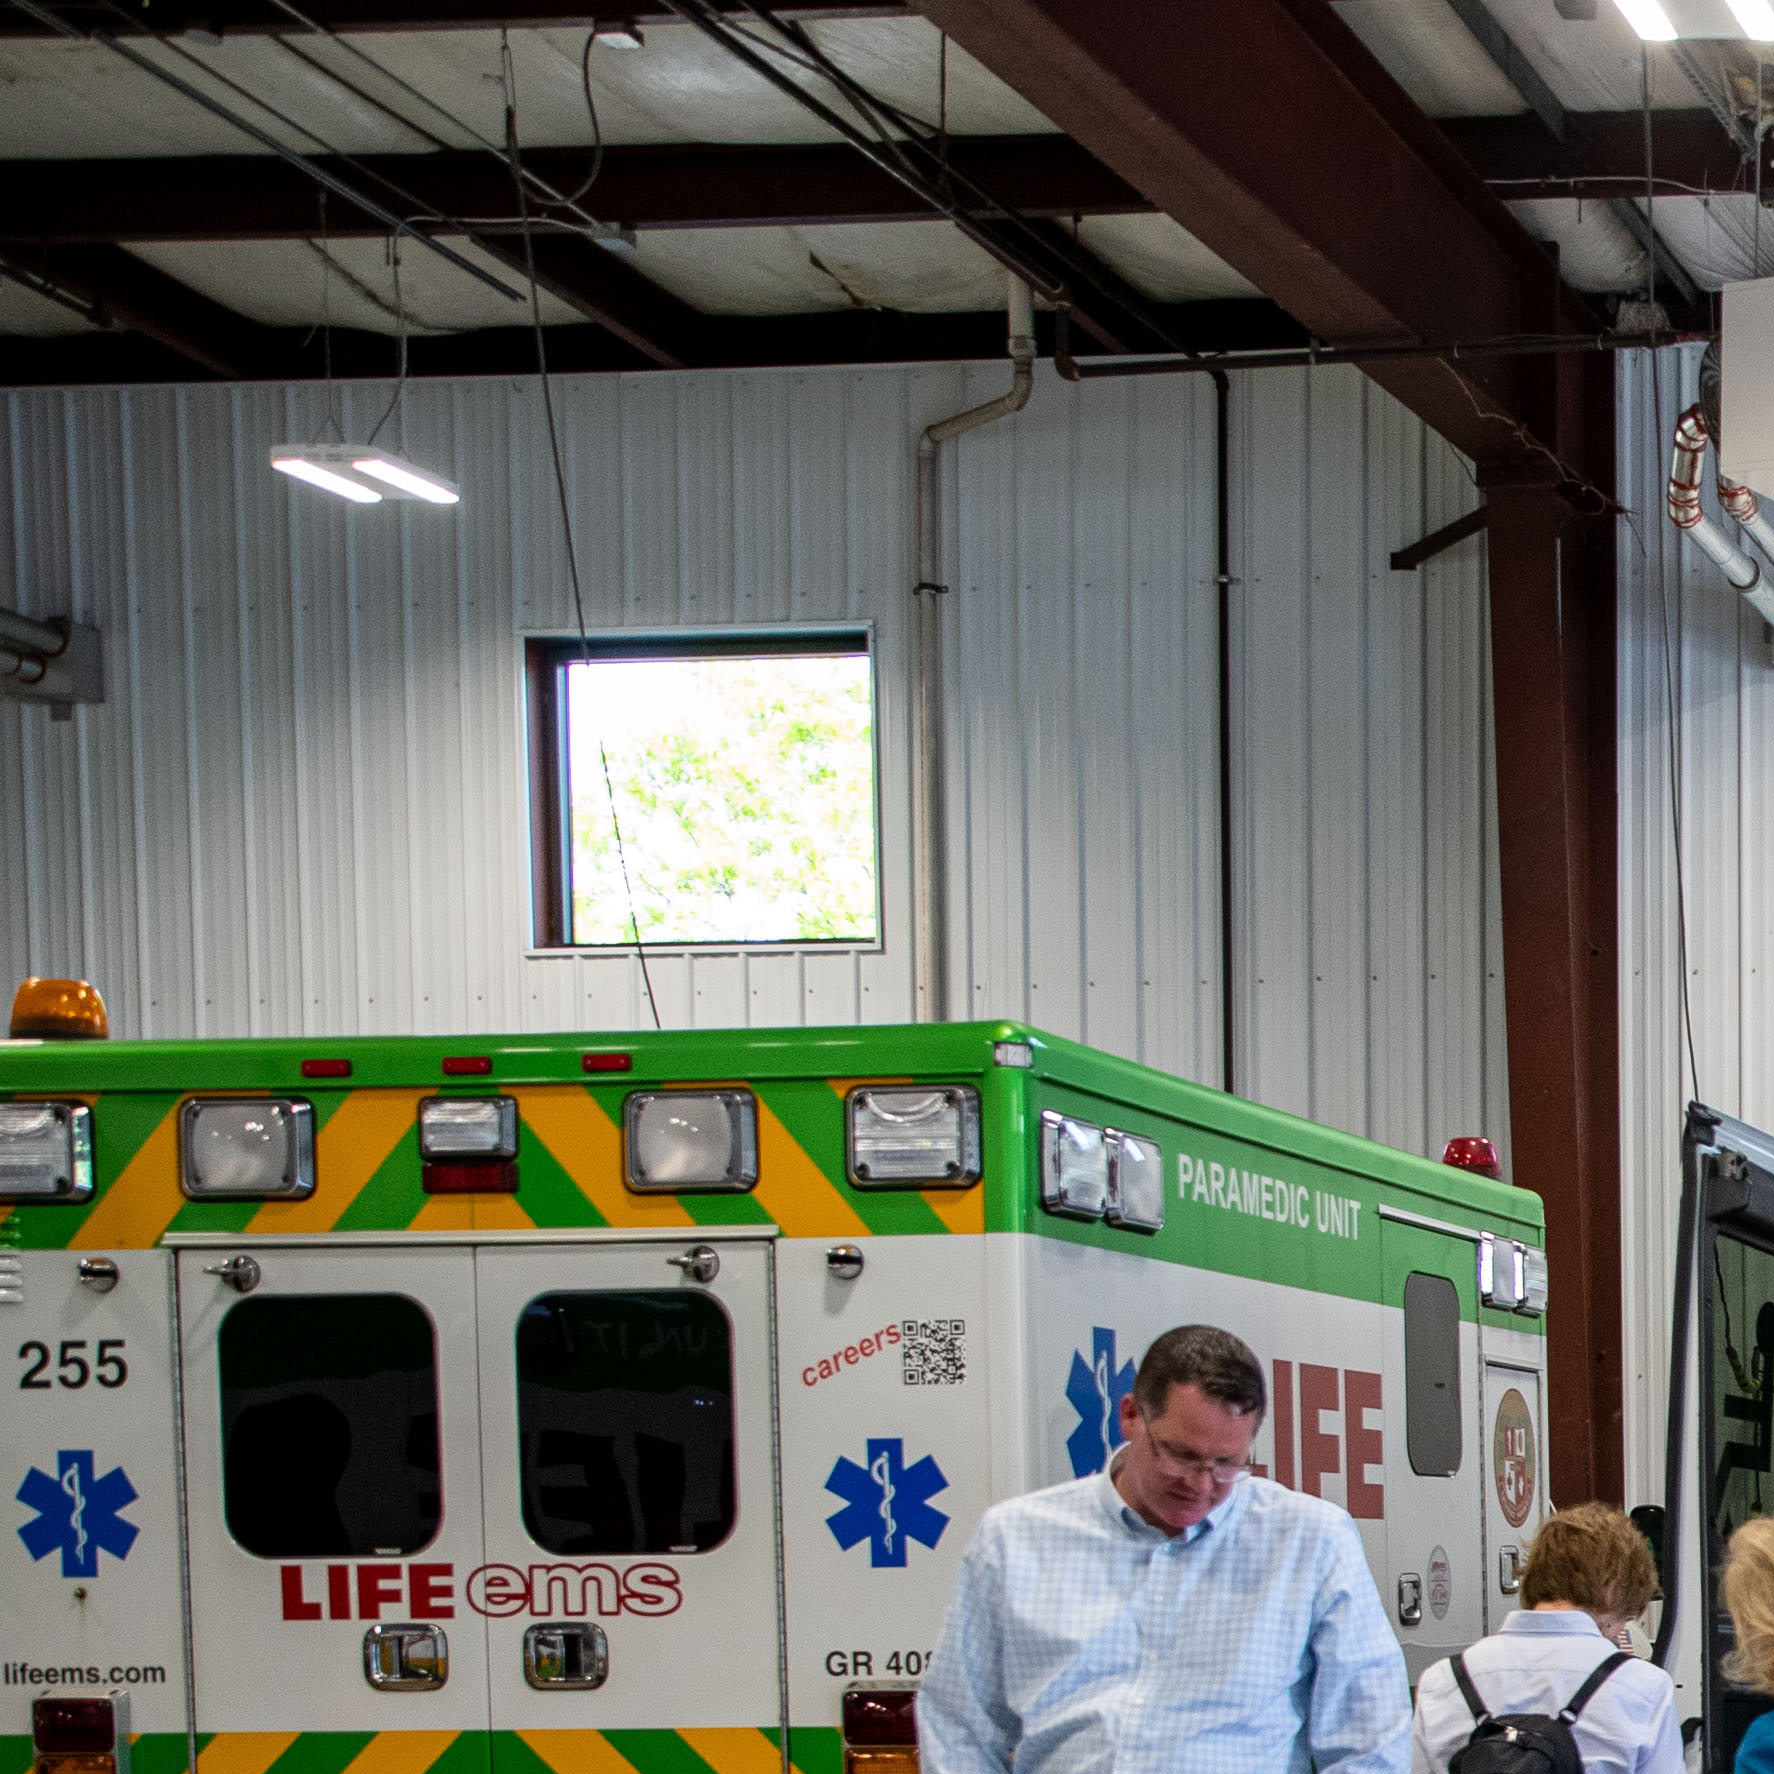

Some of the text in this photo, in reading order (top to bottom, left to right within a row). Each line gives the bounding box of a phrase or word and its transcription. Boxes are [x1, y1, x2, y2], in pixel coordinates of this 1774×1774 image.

[1178, 1153, 1362, 1240] PARAMEDIC UNIT
[18, 1339, 129, 1389] 255
[802, 1323, 902, 1387] careers
[1251, 1358, 1385, 1519] IFE
[281, 1562, 684, 1621] LIFE ems
[4, 1662, 166, 1685] lifeems.com
[825, 1650, 873, 1677] GR
